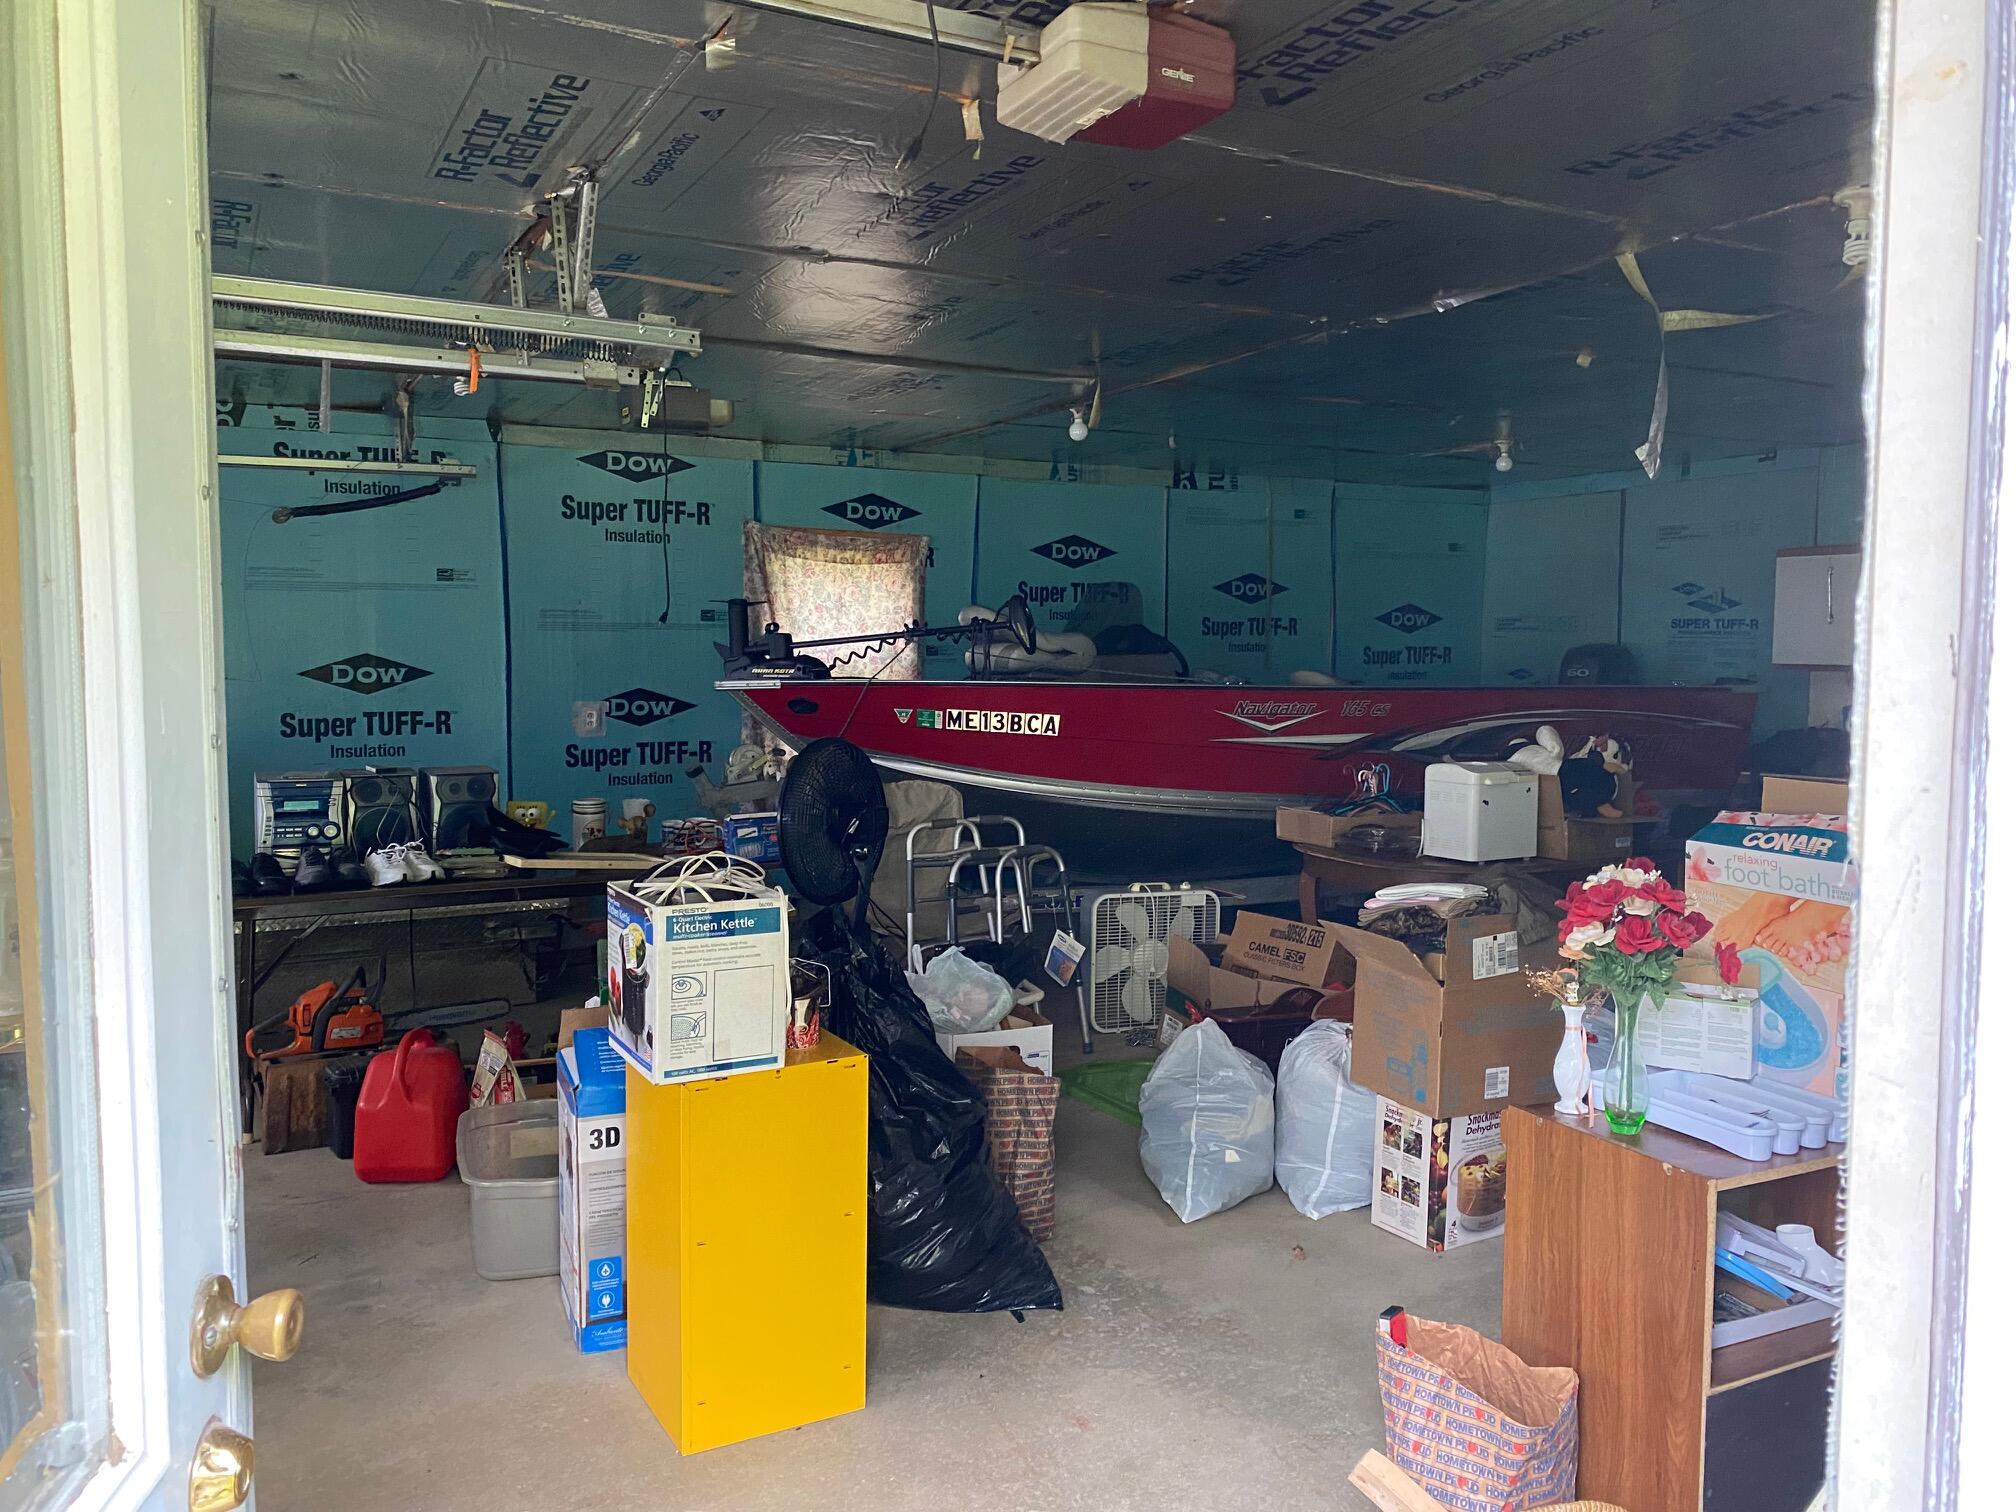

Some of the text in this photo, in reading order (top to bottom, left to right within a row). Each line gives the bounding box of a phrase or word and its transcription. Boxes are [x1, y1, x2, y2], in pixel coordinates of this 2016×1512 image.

[487, 73, 591, 171] Reflective
[434, 108, 512, 183] R-Factor
[324, 479, 400, 496] Insulation
[561, 495, 711, 526] Super TUFF-R
[605, 528, 671, 544] Insulation
[1018, 581, 1067, 607] Super
[1201, 617, 1244, 640] Super
[1670, 617, 1759, 630] SUPER TUFF-R
[1363, 646, 1452, 669] Super TUFF-R
[1232, 700, 1318, 719] Navigator
[1340, 700, 1371, 717] 165
[280, 710, 452, 743] Super TUFF-R
[947, 709, 1059, 736] ME13BCA
[330, 744, 406, 758] Insulation
[565, 740, 713, 772] Super TUFF-R
[608, 772, 673, 786] Insulation
[1742, 832, 1834, 857] CONAIR
[1733, 853, 1778, 870] relaxing
[1725, 858, 1830, 899] foot bath
[672, 907, 708, 915] PRESTO
[673, 917, 755, 934] Kitchen Kettle
[1248, 941, 1306, 963] CAMEL FSC
[589, 1126, 620, 1149] 3D
[1446, 1416, 1501, 1446] HOMETOWN
[1436, 1449, 1495, 1479] HOMETOWN
